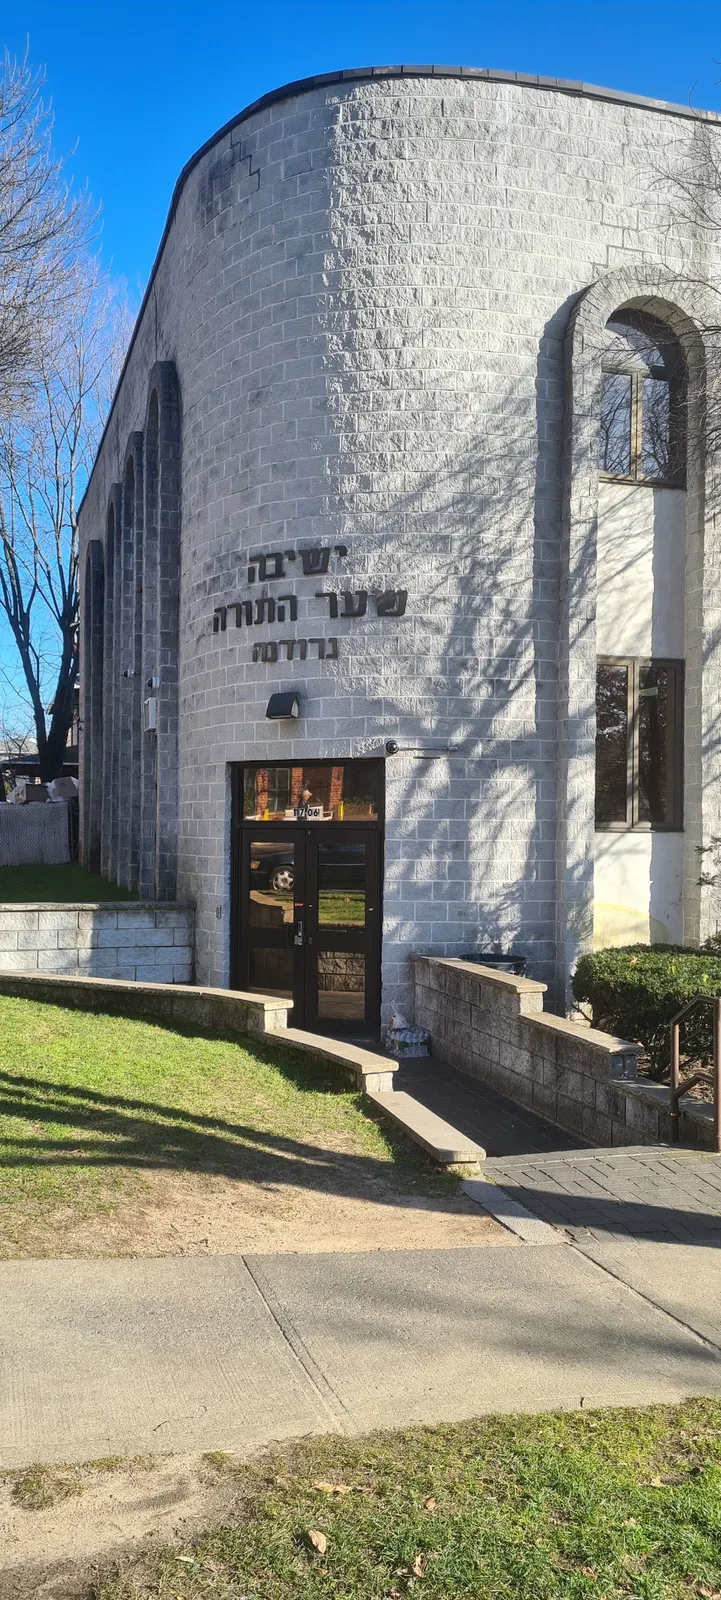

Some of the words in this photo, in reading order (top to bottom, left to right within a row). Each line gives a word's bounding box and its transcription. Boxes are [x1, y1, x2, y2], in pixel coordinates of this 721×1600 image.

[248, 545, 348, 584] ישיבה
[213, 595, 298, 633] התורה
[315, 590, 408, 618] שער
[252, 637, 338, 662] גרודנה
